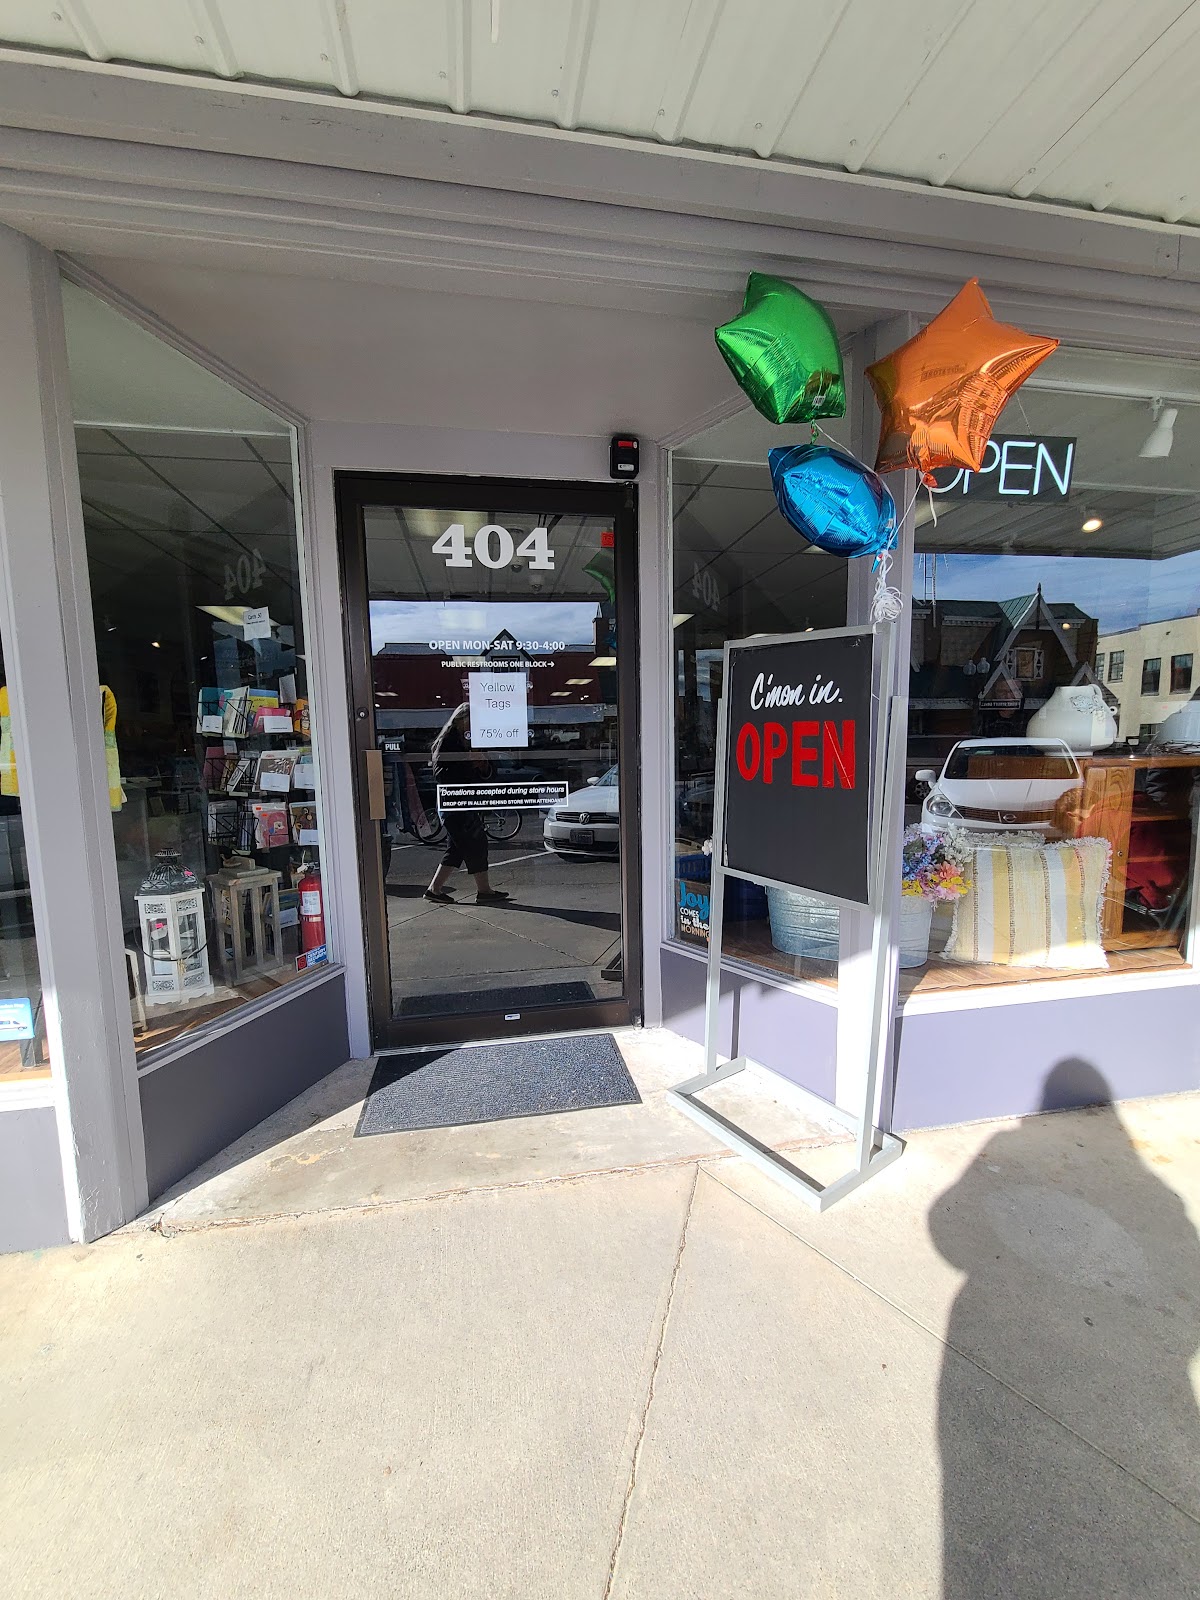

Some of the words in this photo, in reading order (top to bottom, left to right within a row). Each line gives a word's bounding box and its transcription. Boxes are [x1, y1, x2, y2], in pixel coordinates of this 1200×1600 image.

[431, 524, 555, 570] 404
[428, 640, 460, 650] OPEN
[462, 640, 514, 651] MON-SAT
[515, 640, 566, 651] 9:30-4:00
[467, 660, 509, 668] RESTROOMS
[509, 660, 524, 668] ONE
[524, 660, 548, 668] BLOCK
[480, 682, 515, 692] Yellow
[750, 672, 806, 711] C'mon
[808, 674, 844, 705] in.
[485, 698, 511, 710] Tags
[480, 728, 503, 739] 75%
[506, 728, 519, 738] off
[385, 743, 400, 751] PULL
[735, 719, 857, 790] OPEN
[441, 788, 475, 796] Donations
[476, 787, 507, 796] accepted
[507, 786, 528, 795] during
[529, 786, 545, 794] store
[678, 881, 709, 920] Joy
[680, 907, 699, 917] COMES
[681, 915, 691, 925] in
